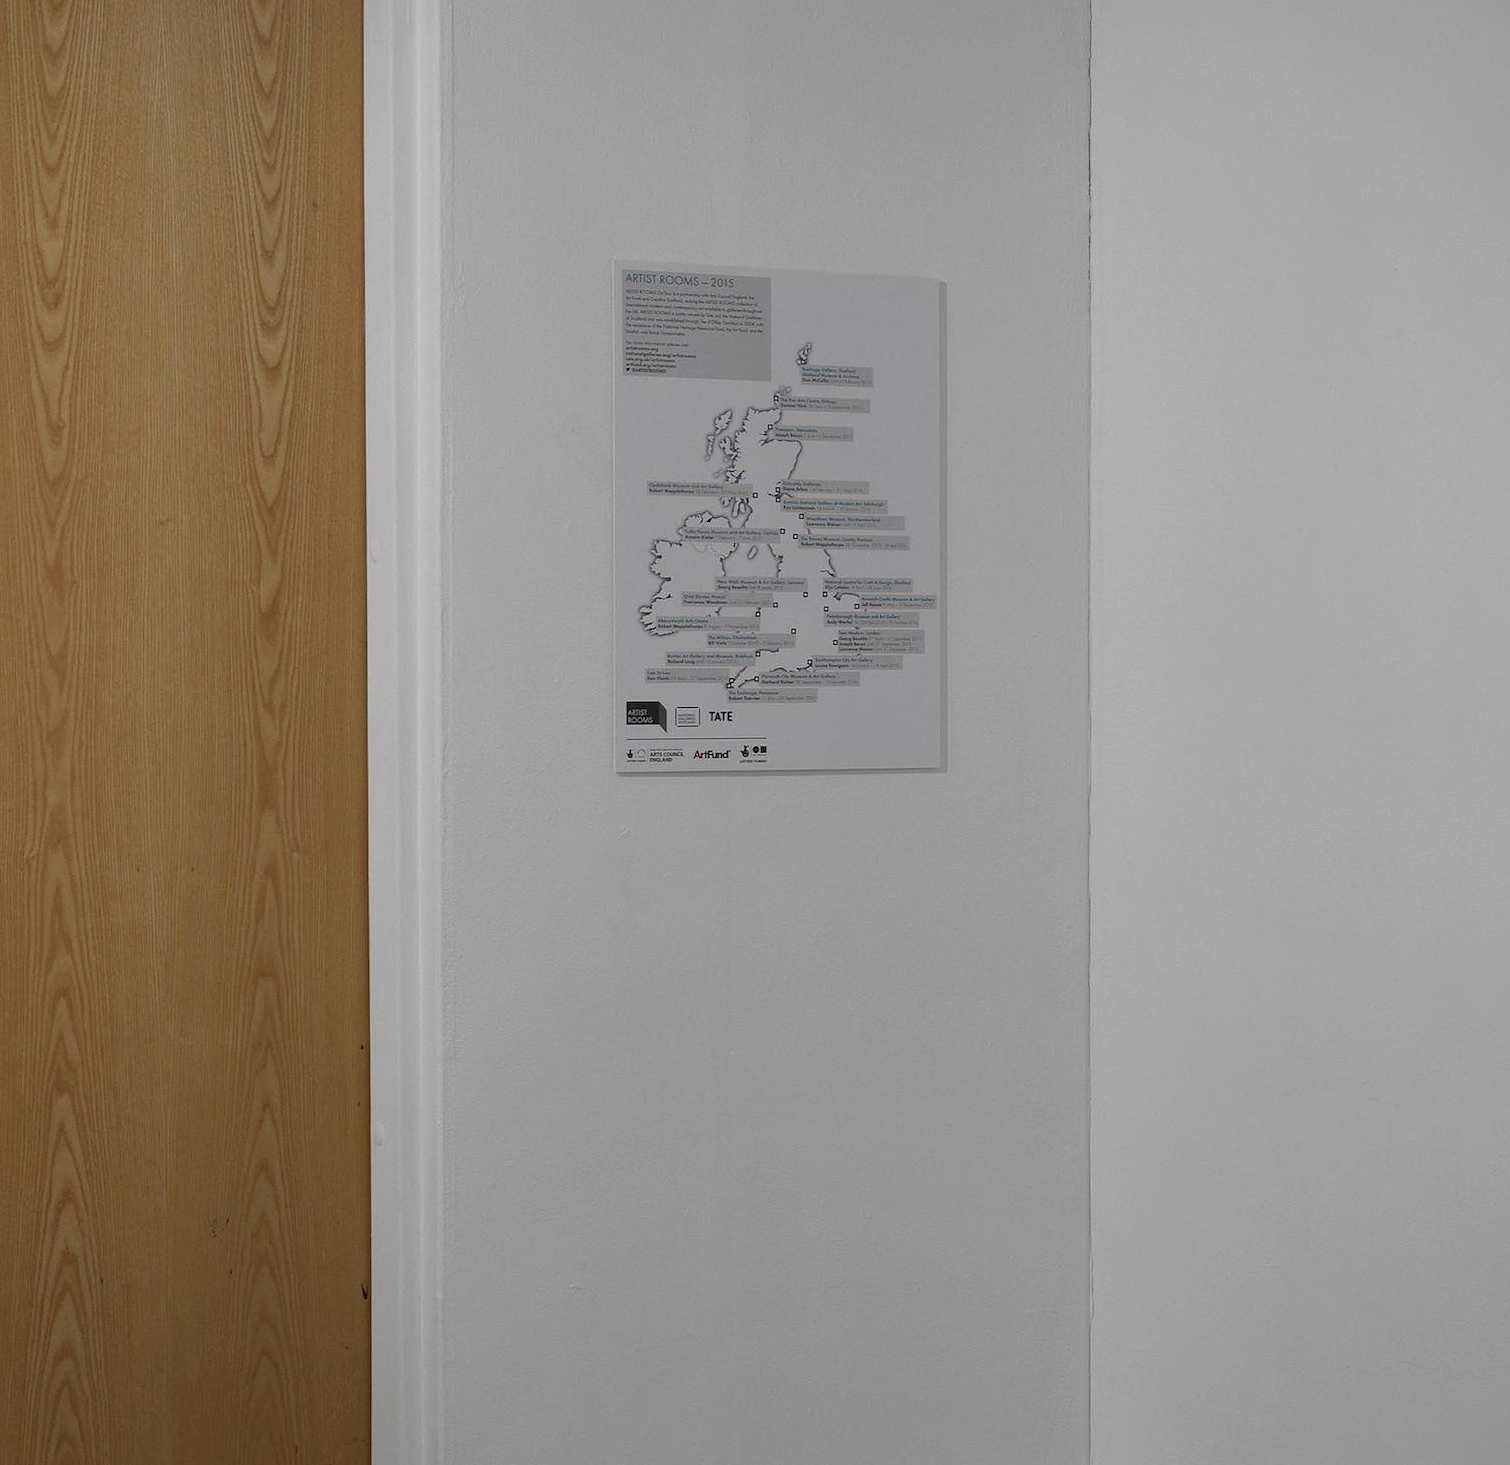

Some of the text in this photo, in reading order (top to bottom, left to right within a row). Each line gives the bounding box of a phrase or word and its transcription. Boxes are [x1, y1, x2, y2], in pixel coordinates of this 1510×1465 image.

[626, 274, 657, 284] ARTIST
[659, 275, 699, 286] ROOMS
[710, 277, 734, 288] 2015
[627, 716, 654, 724] ROOMS
[708, 711, 733, 722] TATE
[693, 750, 729, 760] ArtFund
